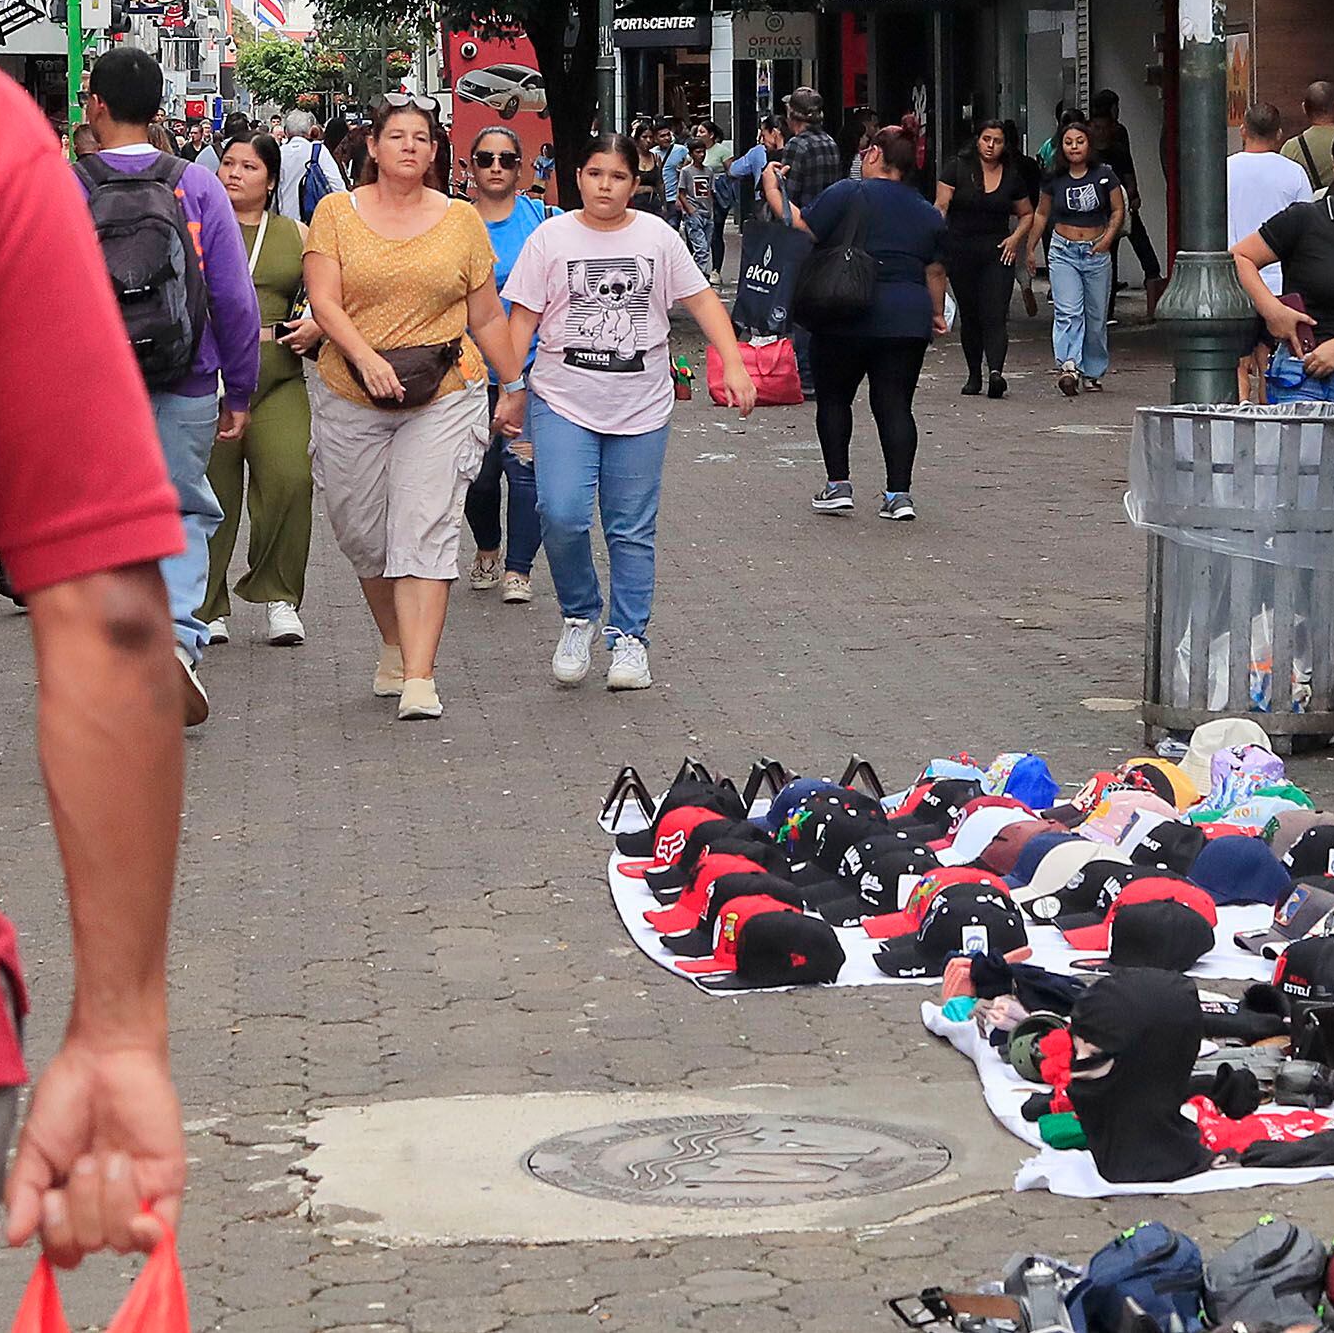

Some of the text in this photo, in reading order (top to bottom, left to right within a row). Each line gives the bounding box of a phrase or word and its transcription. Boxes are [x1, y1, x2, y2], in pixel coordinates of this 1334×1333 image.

[613, 16, 696, 31] PORTSCENTER
[772, 47, 802, 58] MAX
[1283, 982, 1312, 998] ESTELÍ
